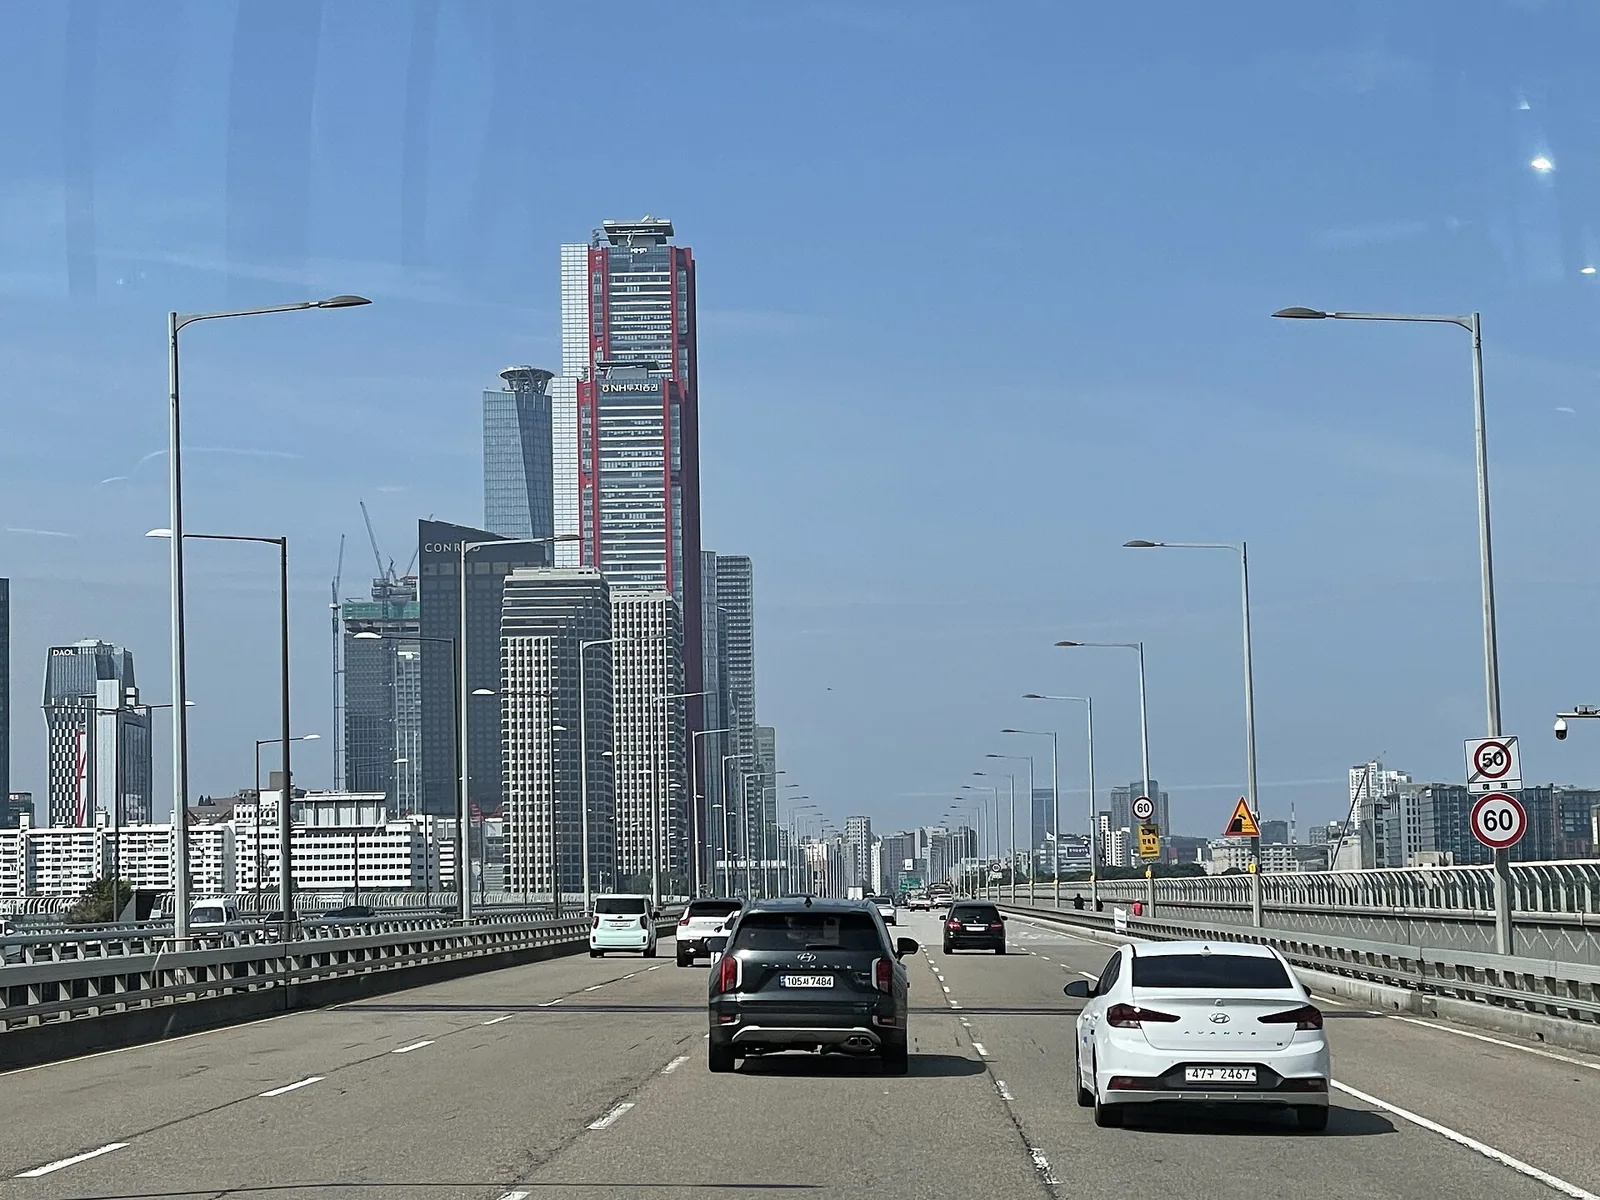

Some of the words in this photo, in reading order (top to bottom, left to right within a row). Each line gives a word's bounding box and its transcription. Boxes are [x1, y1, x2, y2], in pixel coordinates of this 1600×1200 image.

[1482, 751, 1504, 767] 50
[1137, 803, 1150, 813] 60
[1483, 809, 1513, 832] 60
[811, 976, 832, 986] 7484
[1220, 1068, 1250, 1079] 2467
